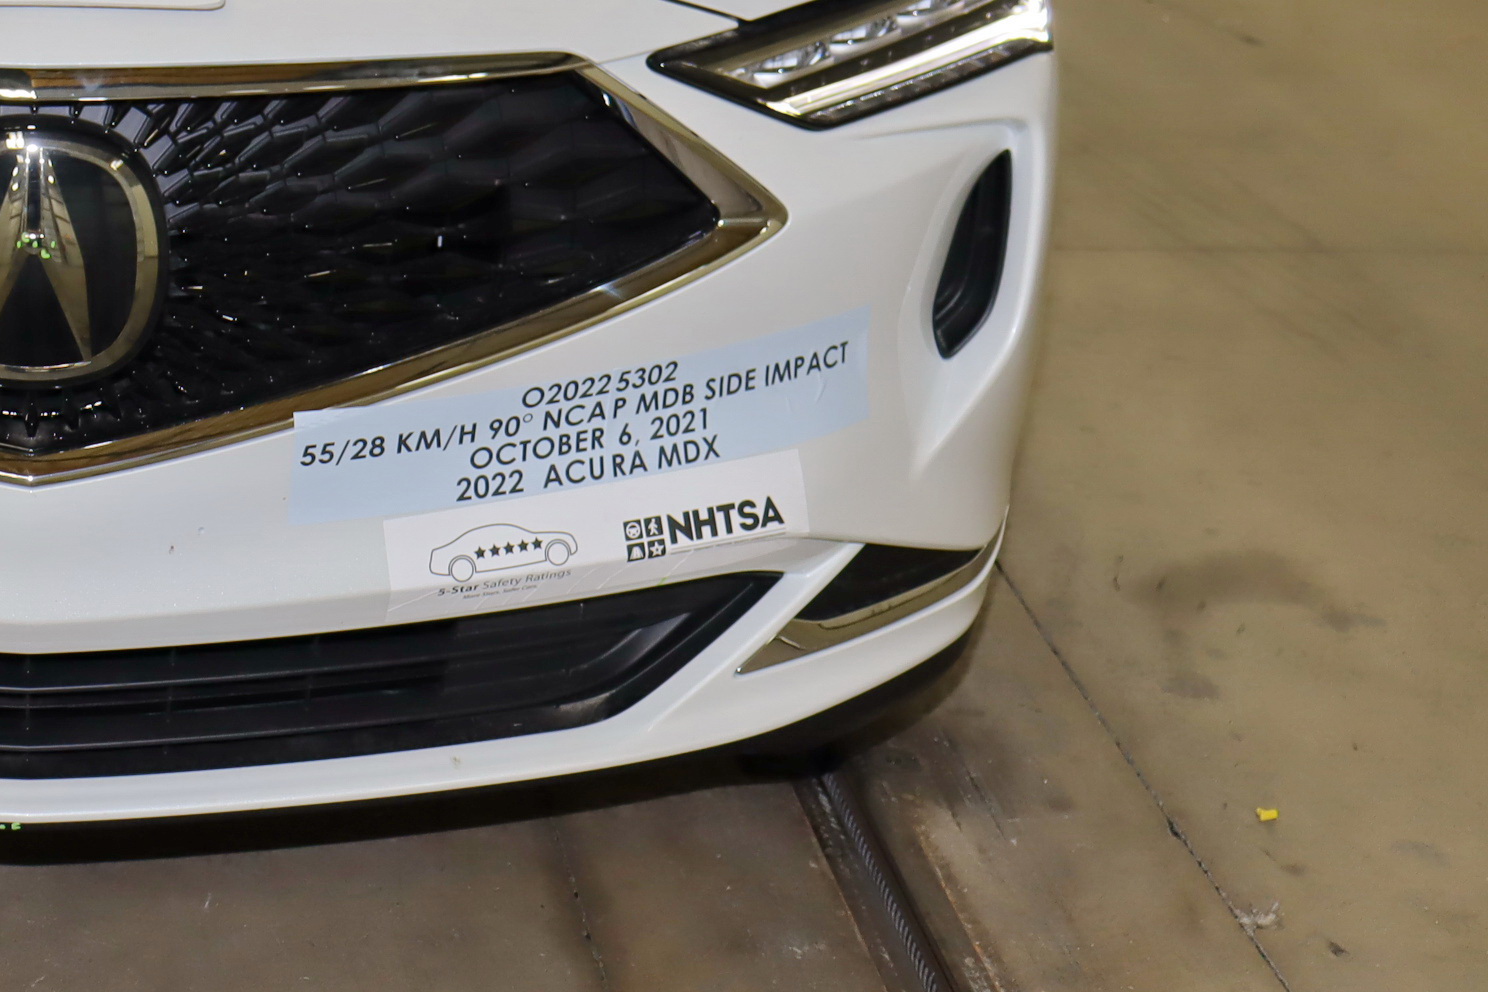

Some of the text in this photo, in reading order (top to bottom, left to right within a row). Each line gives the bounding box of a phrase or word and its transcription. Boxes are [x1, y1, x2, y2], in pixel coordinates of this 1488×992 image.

[300, 341, 849, 466] 55/28 KM/H 90° NCAP MDB SIDE IMPACT
[456, 434, 721, 502] 2022 ACURA MDX
[470, 408, 709, 469] OCTOBER 6, 2021
[666, 496, 785, 544] NHTSA
[437, 568, 572, 597] 5-Star Safety Ratings
